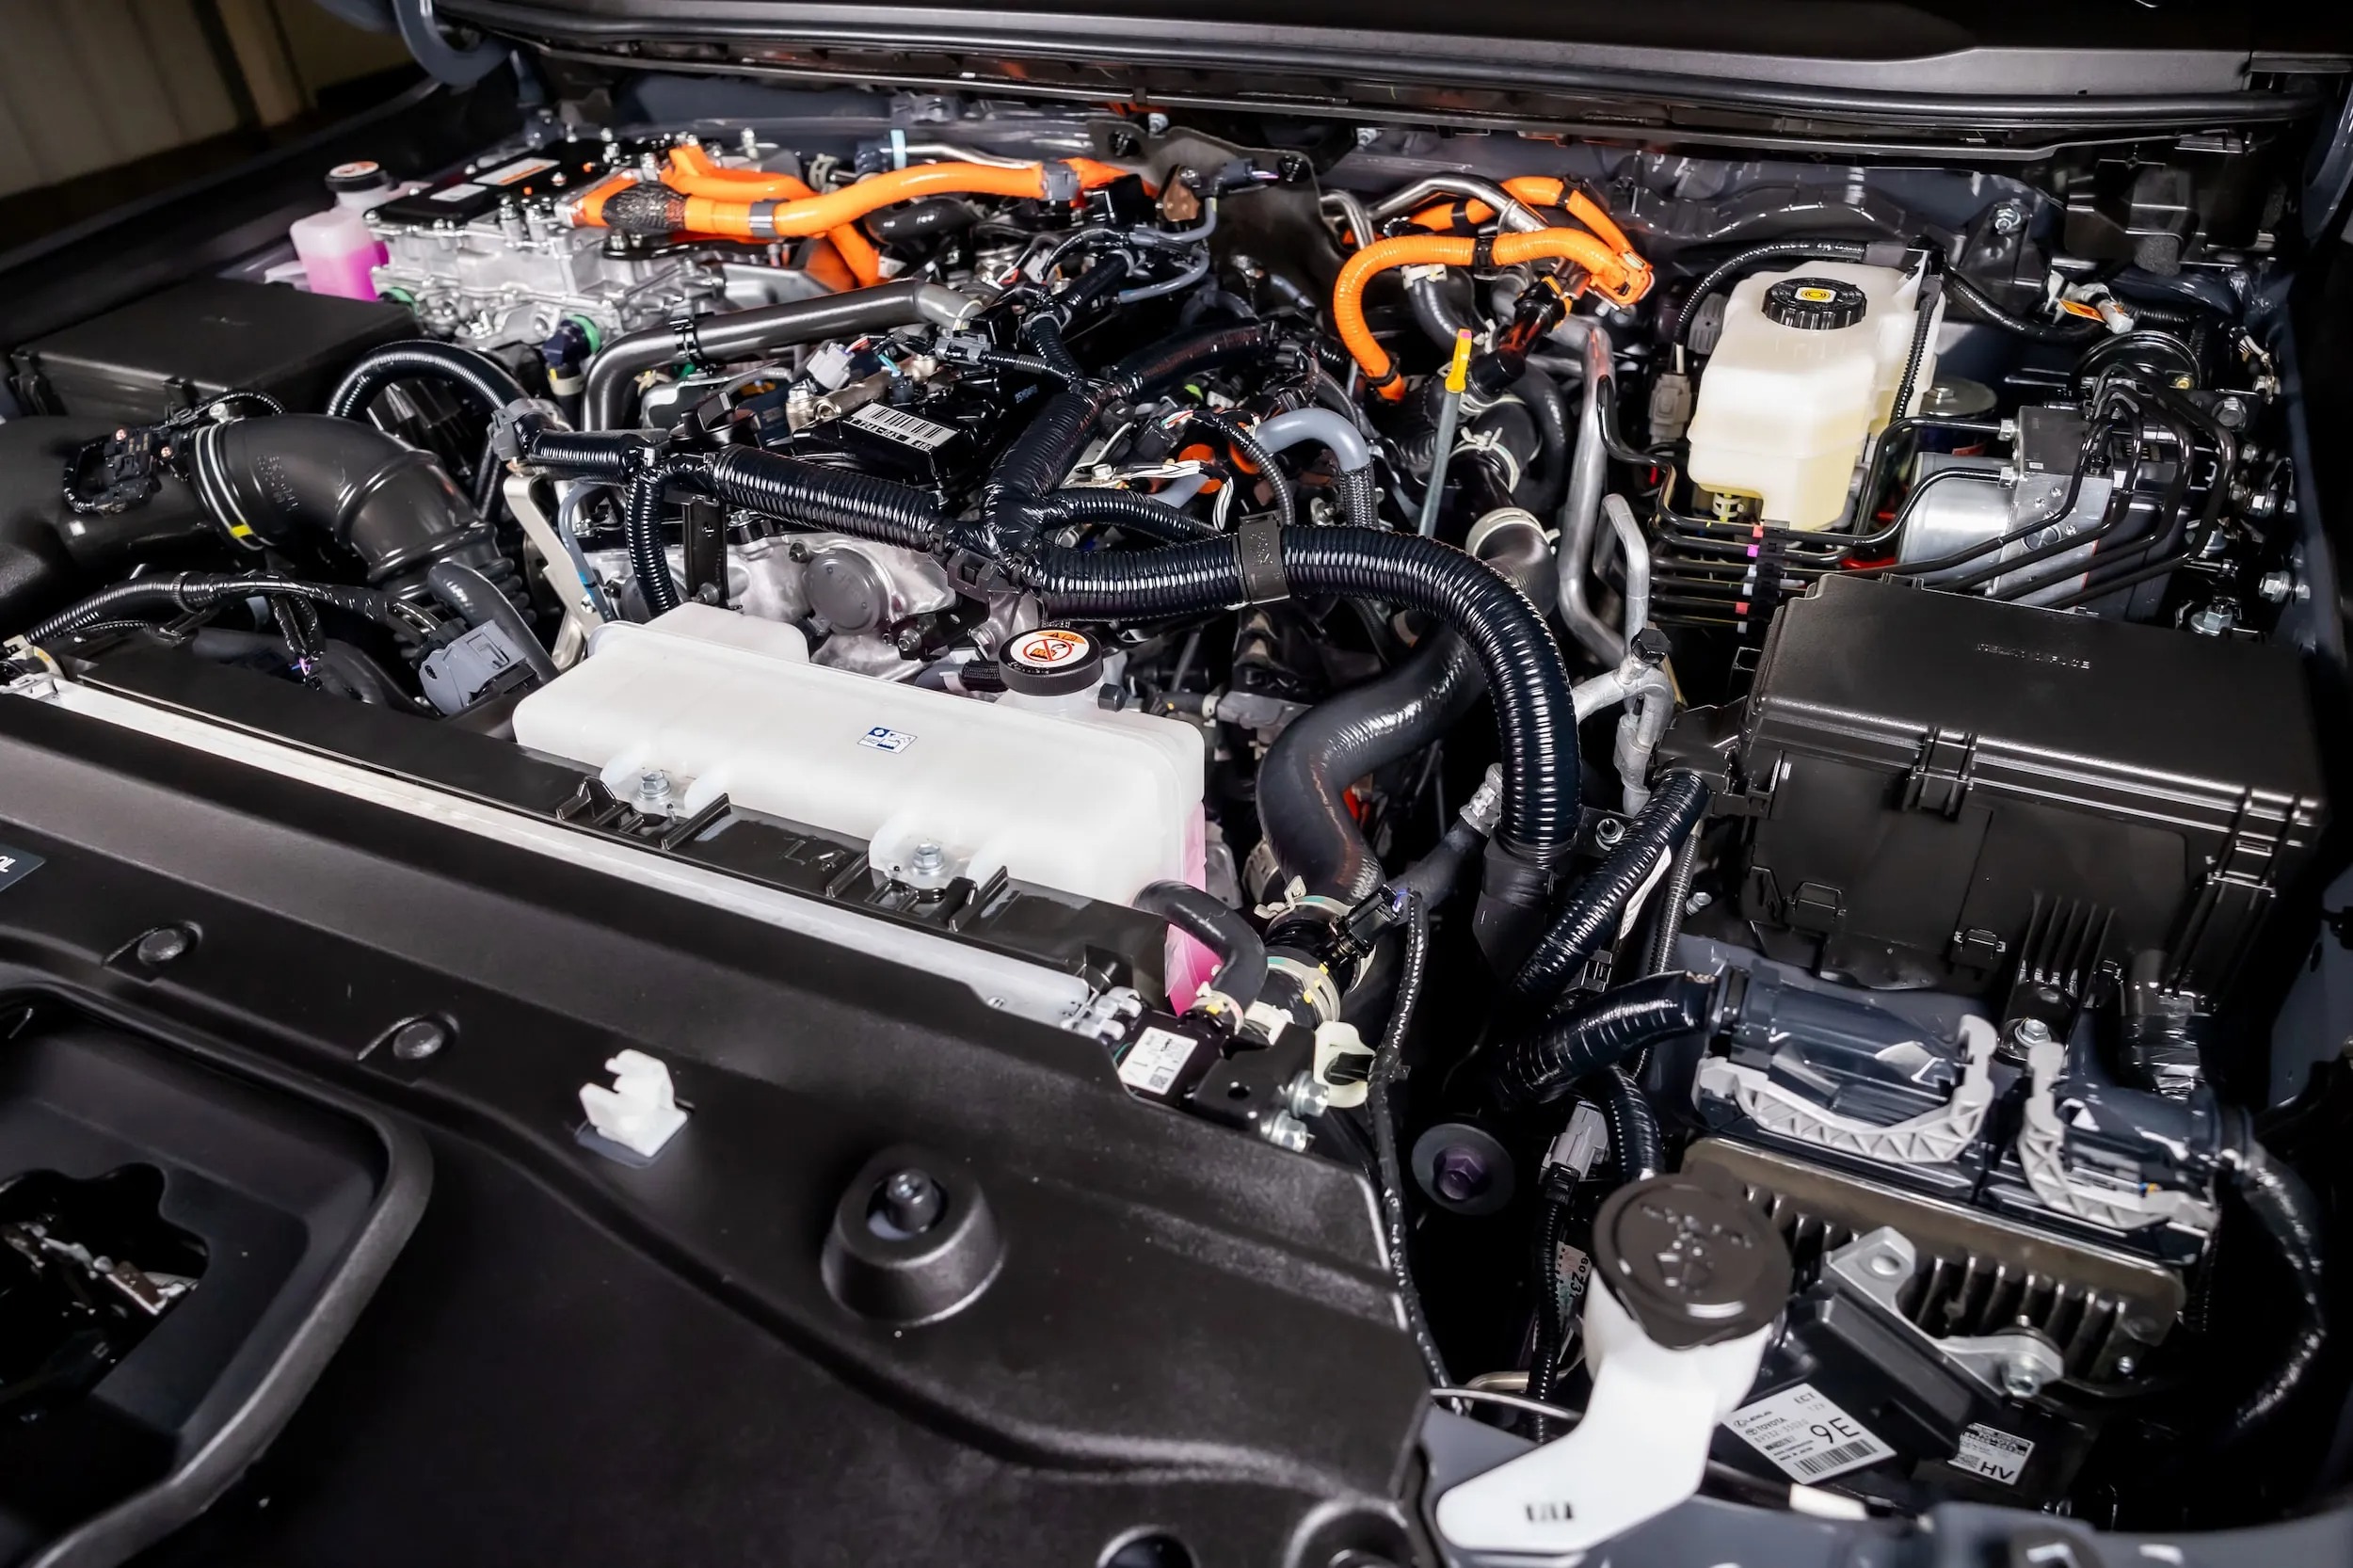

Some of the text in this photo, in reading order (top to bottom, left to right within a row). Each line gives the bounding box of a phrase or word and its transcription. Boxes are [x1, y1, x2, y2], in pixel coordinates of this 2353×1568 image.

[1756, 1416, 1787, 1432] TOYOTA
[1810, 1416, 1861, 1445] 9E
[1979, 1461, 2016, 1480] HV
